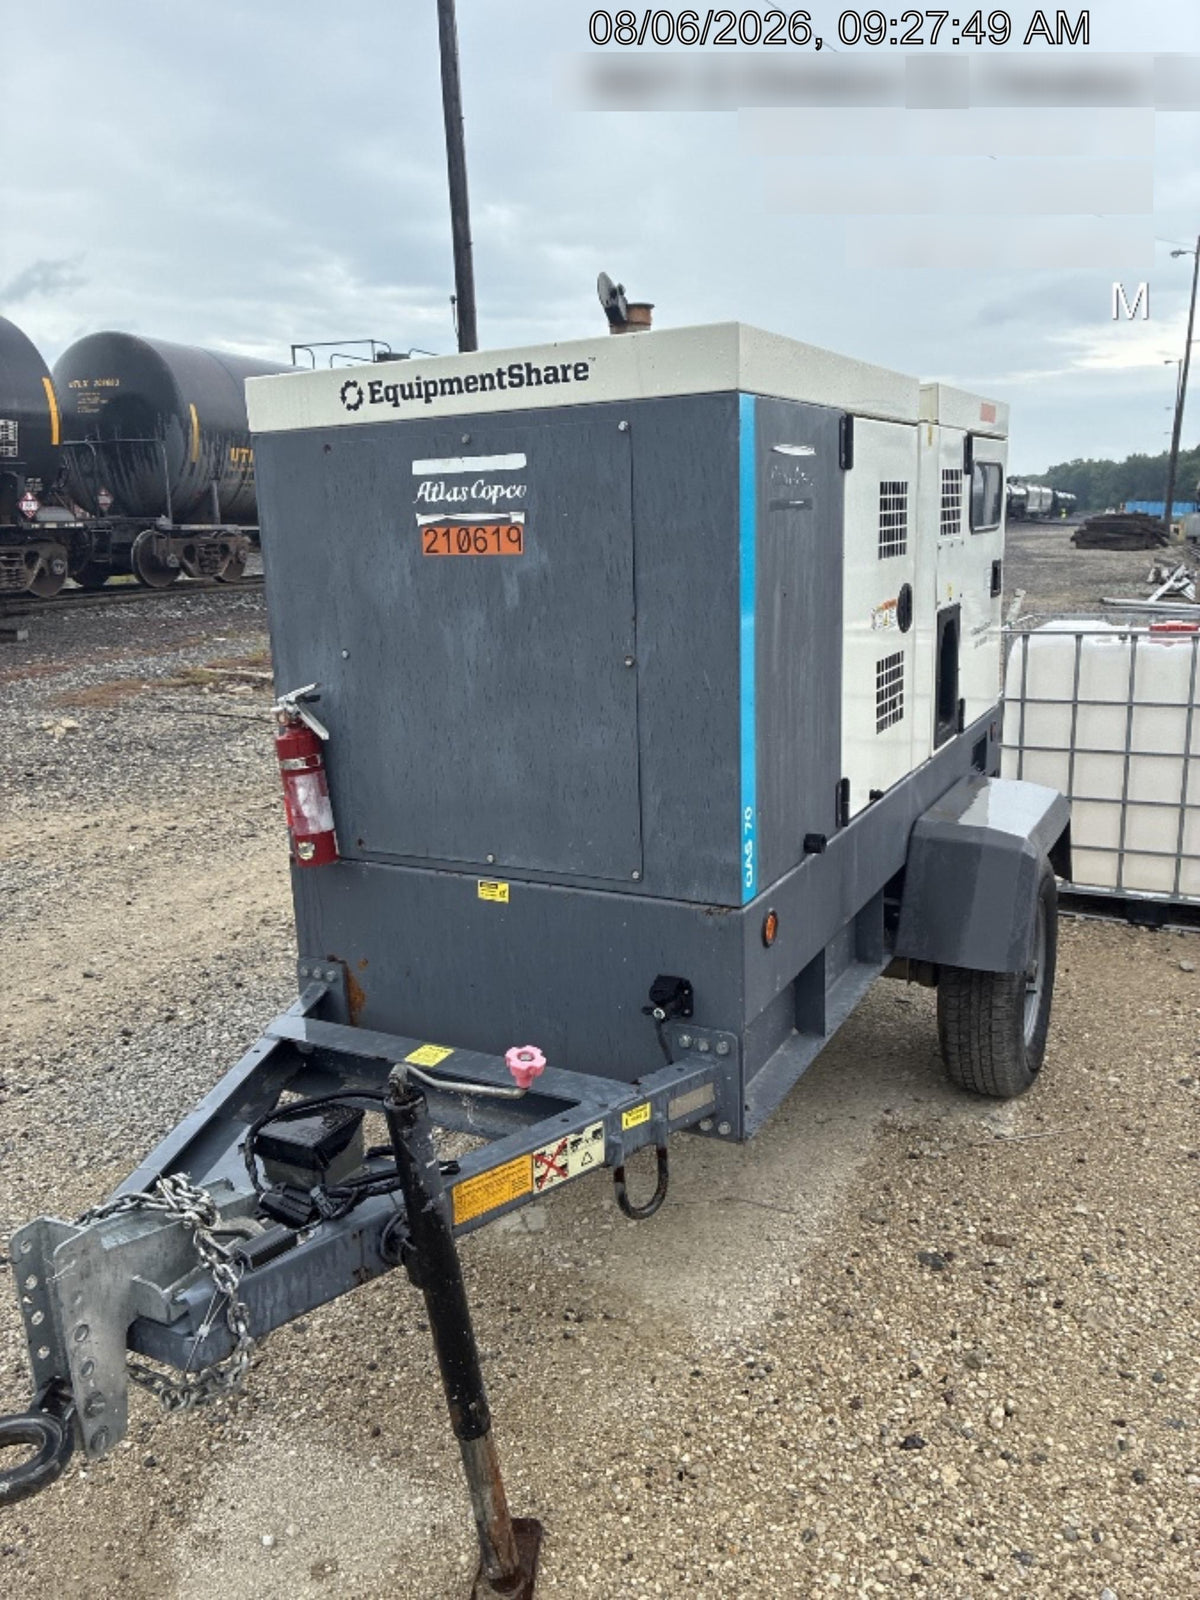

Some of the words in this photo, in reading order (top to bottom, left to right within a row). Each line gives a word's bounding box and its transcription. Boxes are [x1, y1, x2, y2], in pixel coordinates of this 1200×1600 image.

[367, 360, 590, 408] EquipmentShare
[412, 481, 468, 504] Atlas
[470, 479, 527, 505] Copco
[424, 525, 522, 553] 210619
[744, 806, 753, 836] 70
